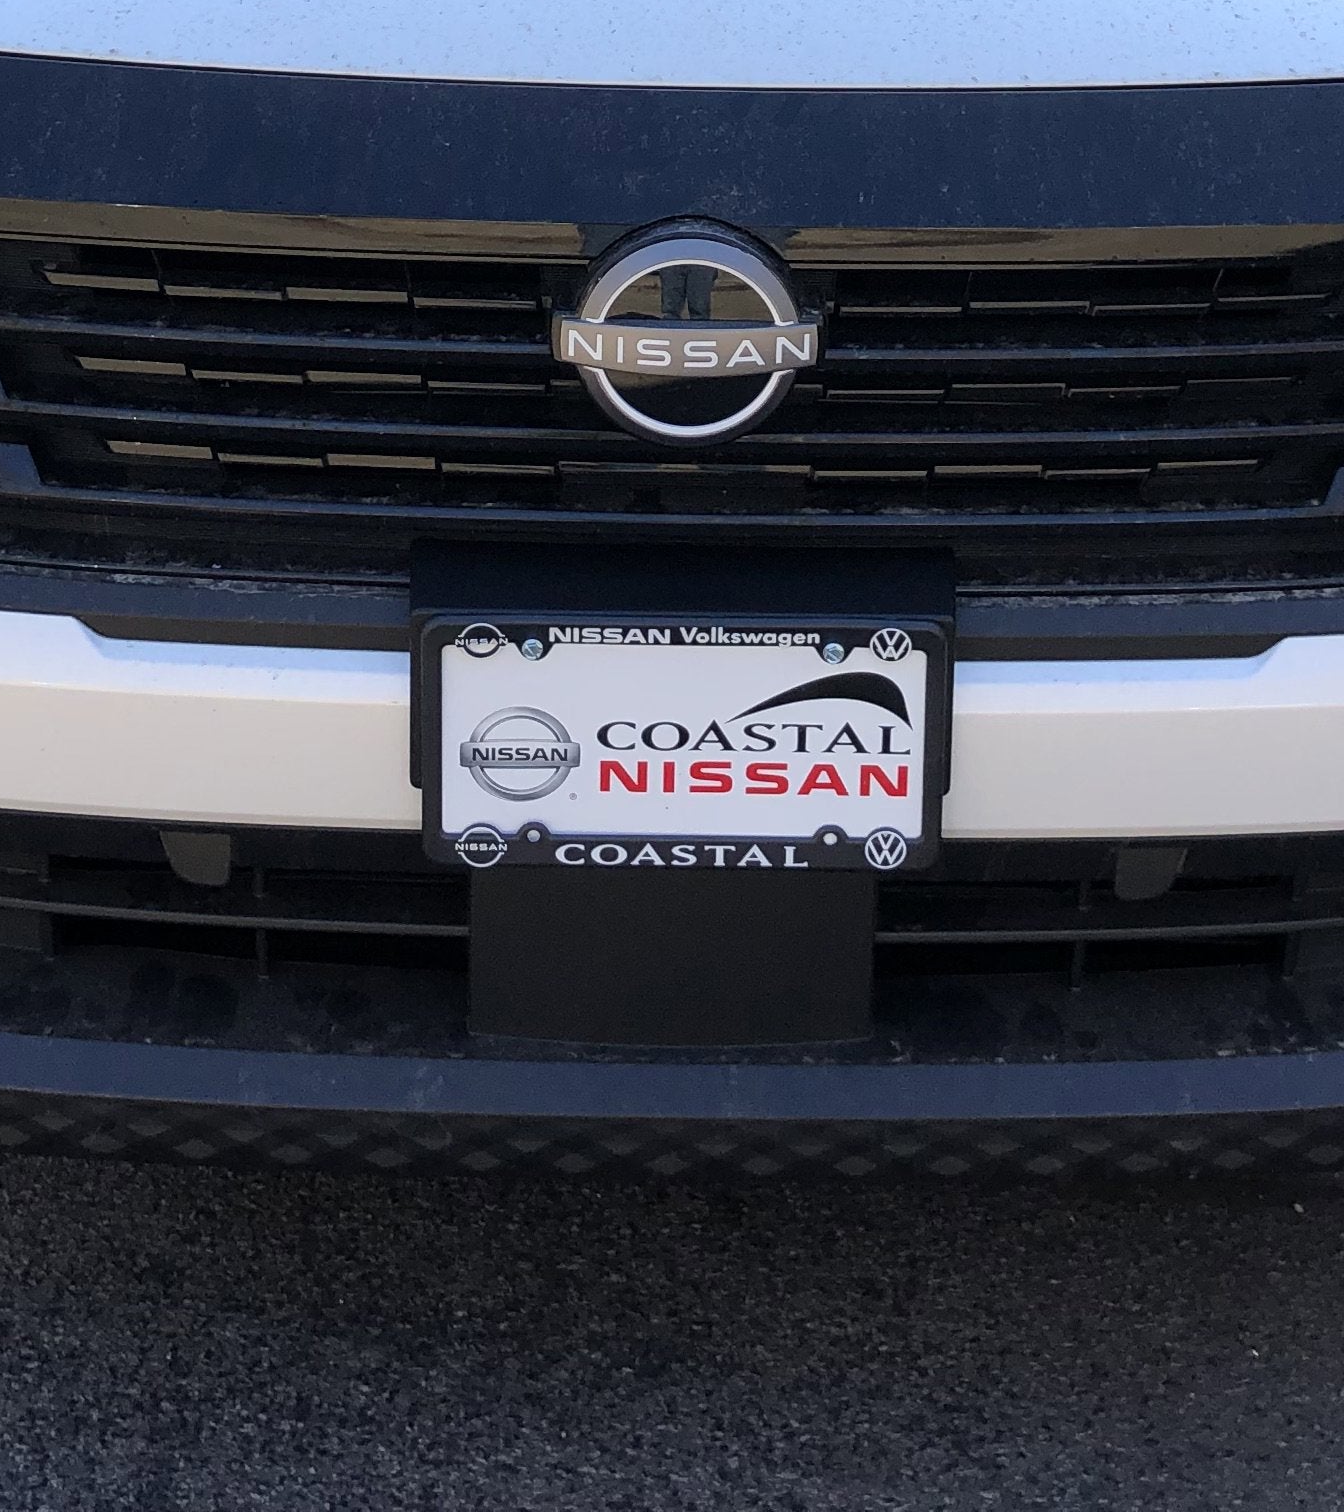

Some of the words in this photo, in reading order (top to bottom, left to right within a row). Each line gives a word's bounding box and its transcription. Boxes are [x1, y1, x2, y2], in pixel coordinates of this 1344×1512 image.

[567, 329, 811, 369] NISSAN
[455, 635, 508, 647] NISSAN
[548, 626, 671, 644] NISSAN
[680, 625, 821, 646] Volkswagen
[595, 719, 912, 755] COASTAL
[471, 746, 569, 762] NISSAN
[599, 760, 909, 797] NISSAN
[455, 842, 508, 853] NISSAN
[555, 842, 809, 867] COASTAL
